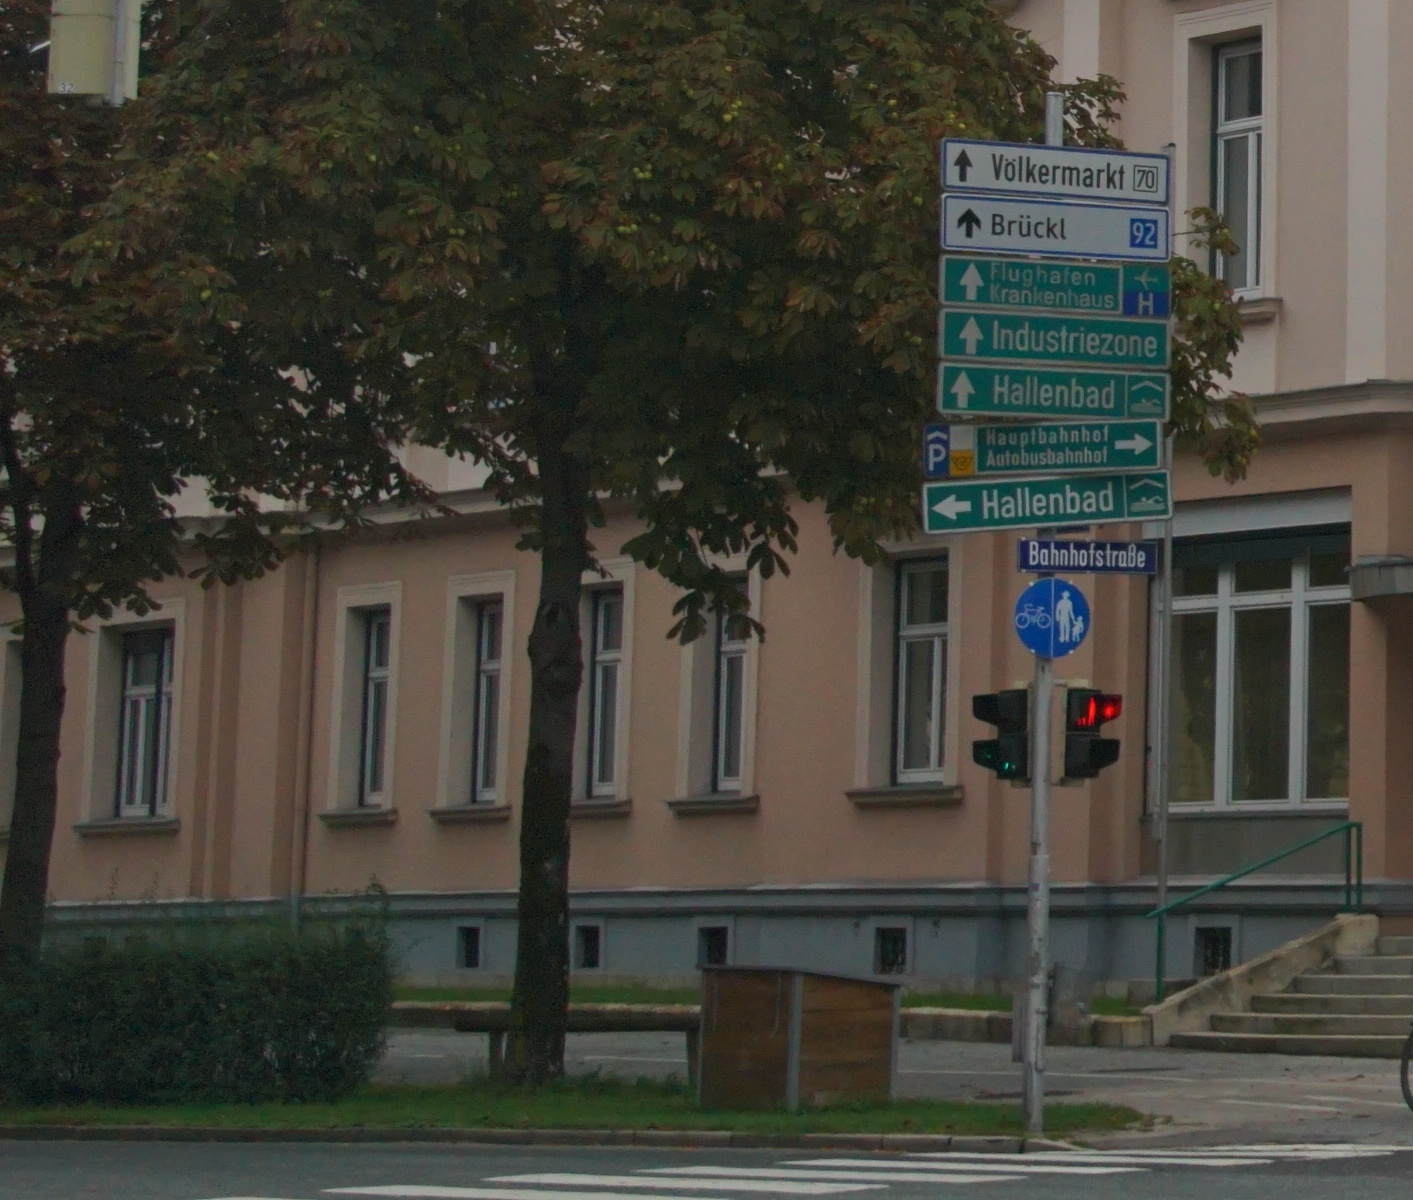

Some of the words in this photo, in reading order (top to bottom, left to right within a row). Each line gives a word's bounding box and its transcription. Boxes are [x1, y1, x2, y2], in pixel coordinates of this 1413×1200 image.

[991, 153, 1126, 190] Völkermarkt
[1136, 170, 1155, 189] 70
[991, 213, 1067, 240] Brückl
[1132, 222, 1156, 245] 92
[990, 263, 1095, 285] Flughafen
[989, 283, 1114, 308] Krankenhaus
[993, 320, 1158, 357] Industriezone
[993, 374, 1115, 409] Hallenbad
[986, 425, 1109, 445] Hauptbahnhof
[928, 444, 946, 471] P
[986, 447, 1108, 467] Autobusbahnhof
[982, 481, 1114, 520] Hallenbad
[1029, 541, 1146, 568] Bahnhofstraße
